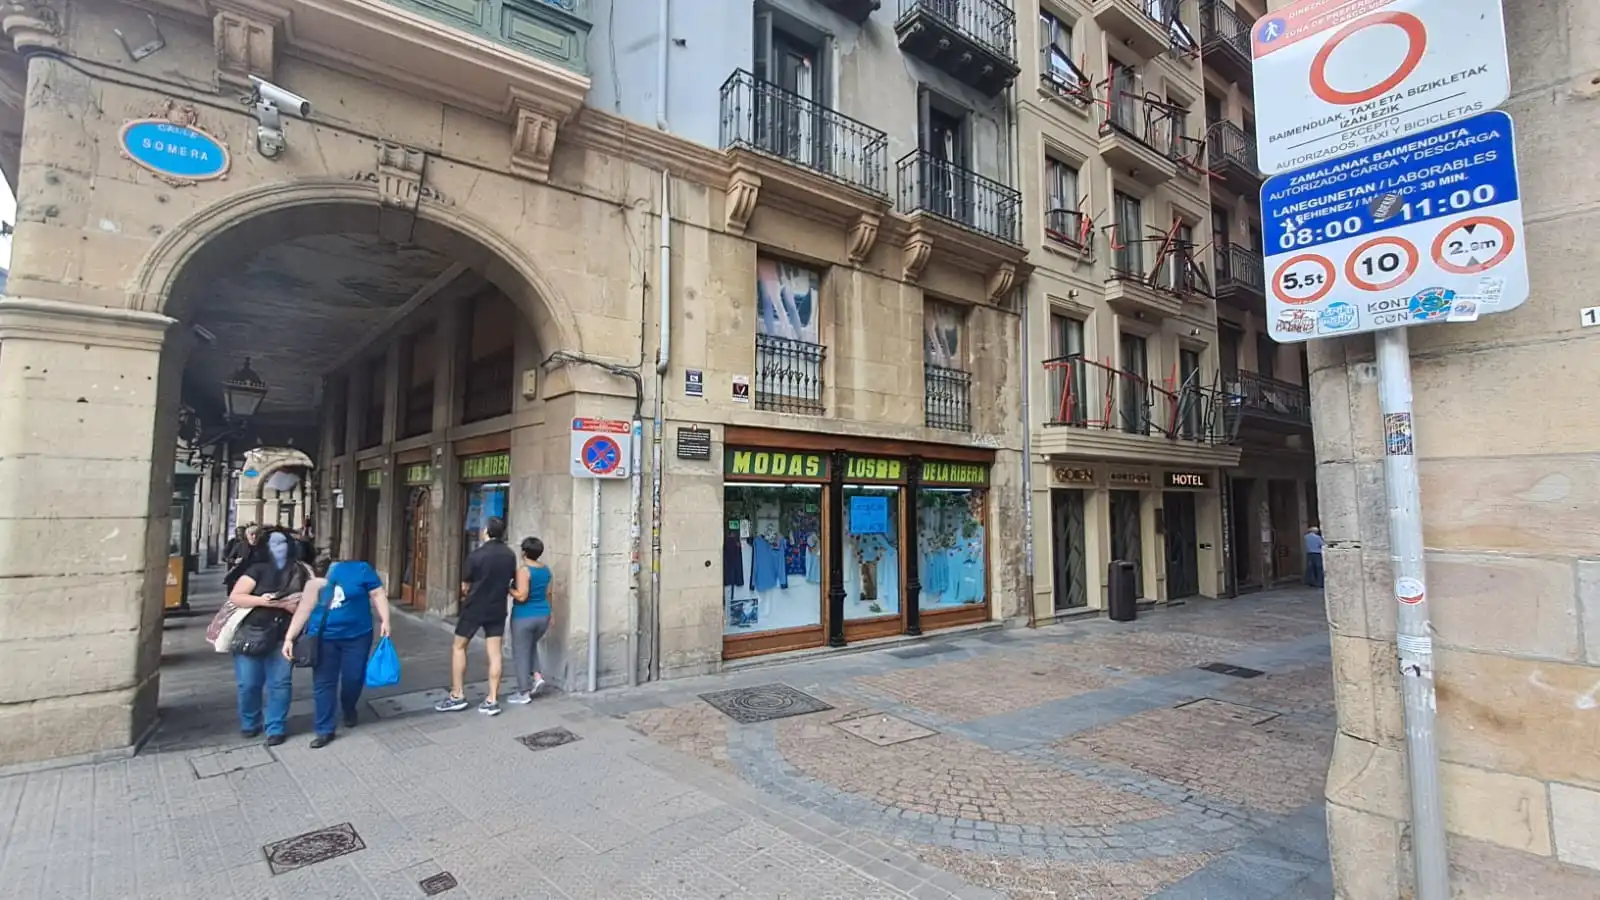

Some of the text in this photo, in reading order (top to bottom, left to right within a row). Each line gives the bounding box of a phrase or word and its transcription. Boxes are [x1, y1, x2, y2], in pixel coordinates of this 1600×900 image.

[1284, 23, 1309, 39] ZONA
[1312, 17, 1324, 27] DE
[1268, 64, 1488, 143] BAIMENDUAK, TAXI ETA BIZIKLETAK
[1340, 104, 1399, 129] IZAN EZIK
[157, 123, 199, 140] CALLE
[1276, 101, 1483, 170] AUTORIZADOS, TAXI Y BICICLETAS
[1341, 117, 1400, 141] EXCEPTO
[142, 138, 209, 161] SOMERA
[1289, 127, 1469, 186] ZAMALANAK BAIMENDUTA
[1269, 130, 1501, 202] AUTORIZADO CARGA Y DESCARGA
[1272, 182, 1376, 218] LANEGUNETAN
[1379, 180, 1385, 190] /
[1387, 150, 1498, 187] LABORABLES
[1420, 179, 1436, 191] 30
[1439, 172, 1470, 186] MIN.
[1279, 216, 1362, 249] 08:00
[1400, 184, 1497, 221] 11:00
[1362, 252, 1400, 276] 10
[1367, 297, 1409, 313] KONT
[484, 454, 512, 477] RIBER
[732, 451, 820, 477] MODAS
[847, 457, 876, 478] LOS
[923, 463, 936, 481] DE
[936, 463, 949, 482] LA
[950, 464, 985, 484] RIBERA
[1171, 473, 1204, 486] HOTEL
